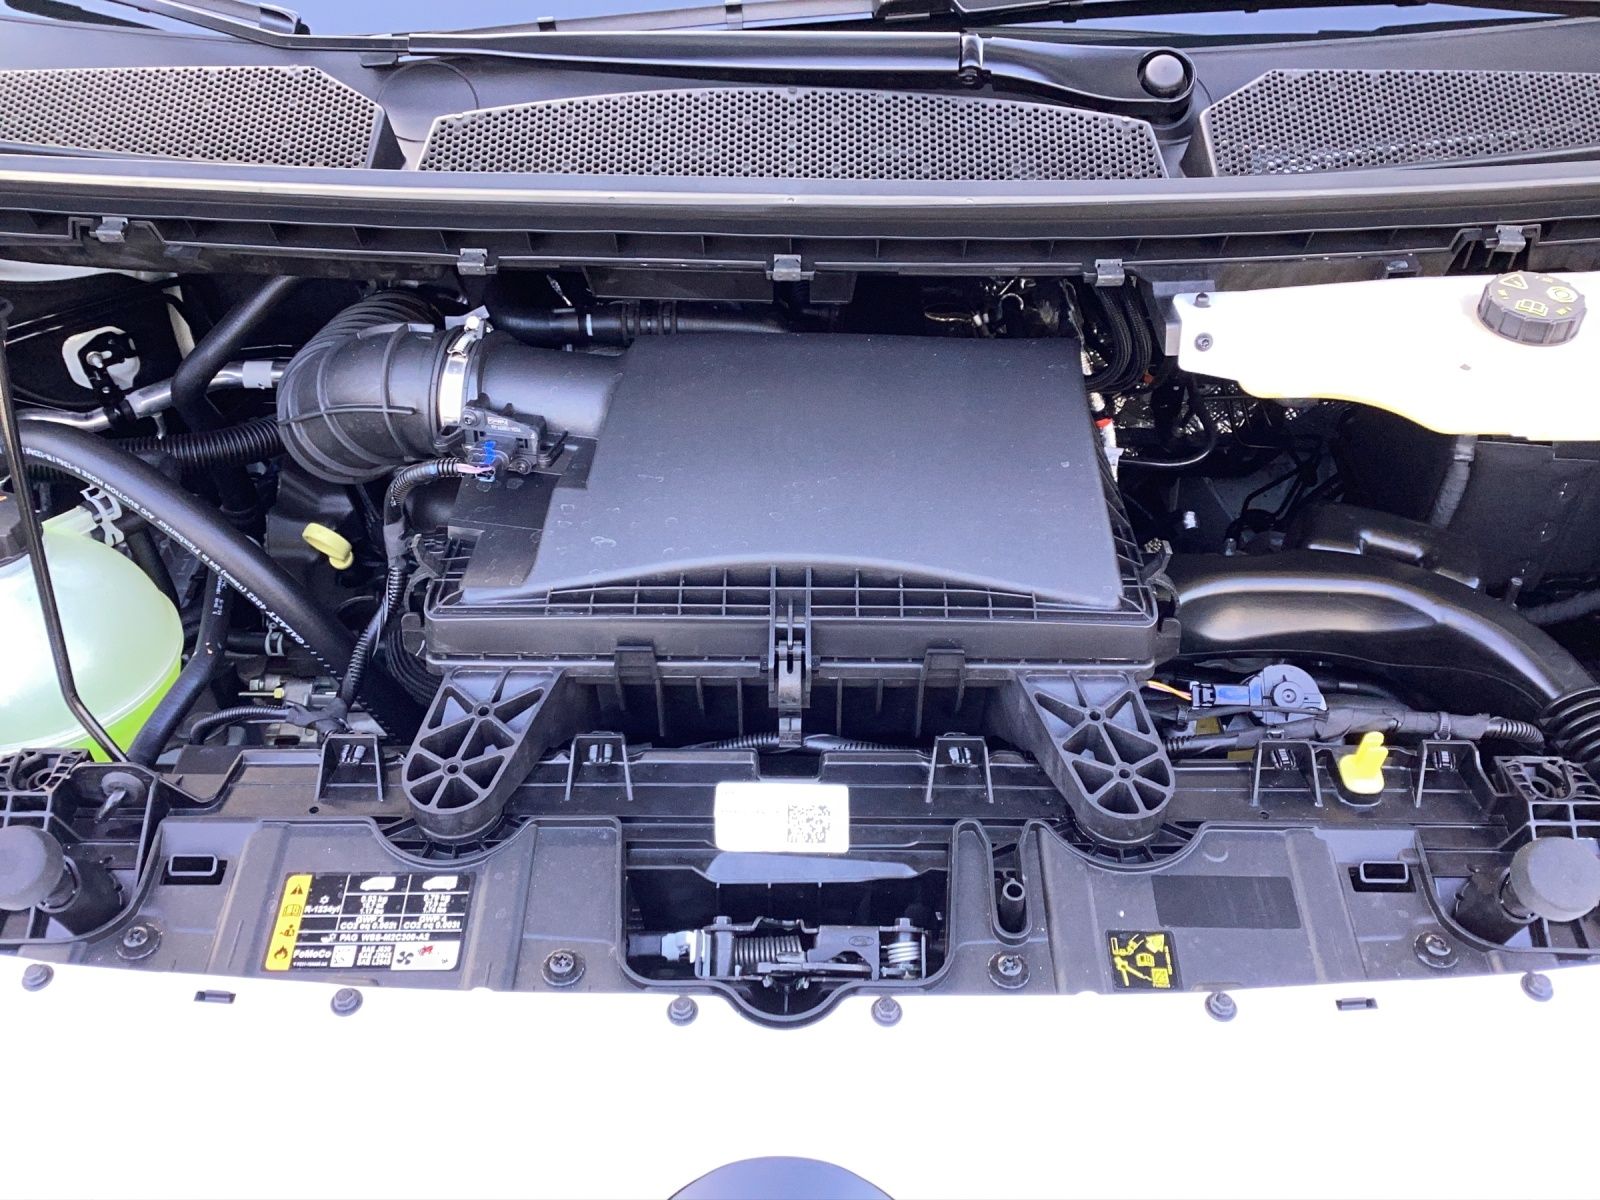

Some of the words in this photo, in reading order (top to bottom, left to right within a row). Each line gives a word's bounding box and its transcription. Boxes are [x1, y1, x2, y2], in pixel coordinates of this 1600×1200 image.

[81, 469, 104, 486] HOSE
[104, 483, 140, 510] SUCTION
[140, 508, 155, 519] A/C
[157, 519, 201, 554] Flexbarrier
[202, 553, 210, 561] in
[266, 611, 305, 644] GALAXY
[304, 905, 340, 914] R-1234yf
[340, 921, 358, 930] CO2
[359, 923, 371, 931] eq
[403, 921, 421, 929] CO2
[423, 922, 434, 930] eq
[339, 933, 358, 942] PAG
[292, 949, 332, 959] FoMoCo
